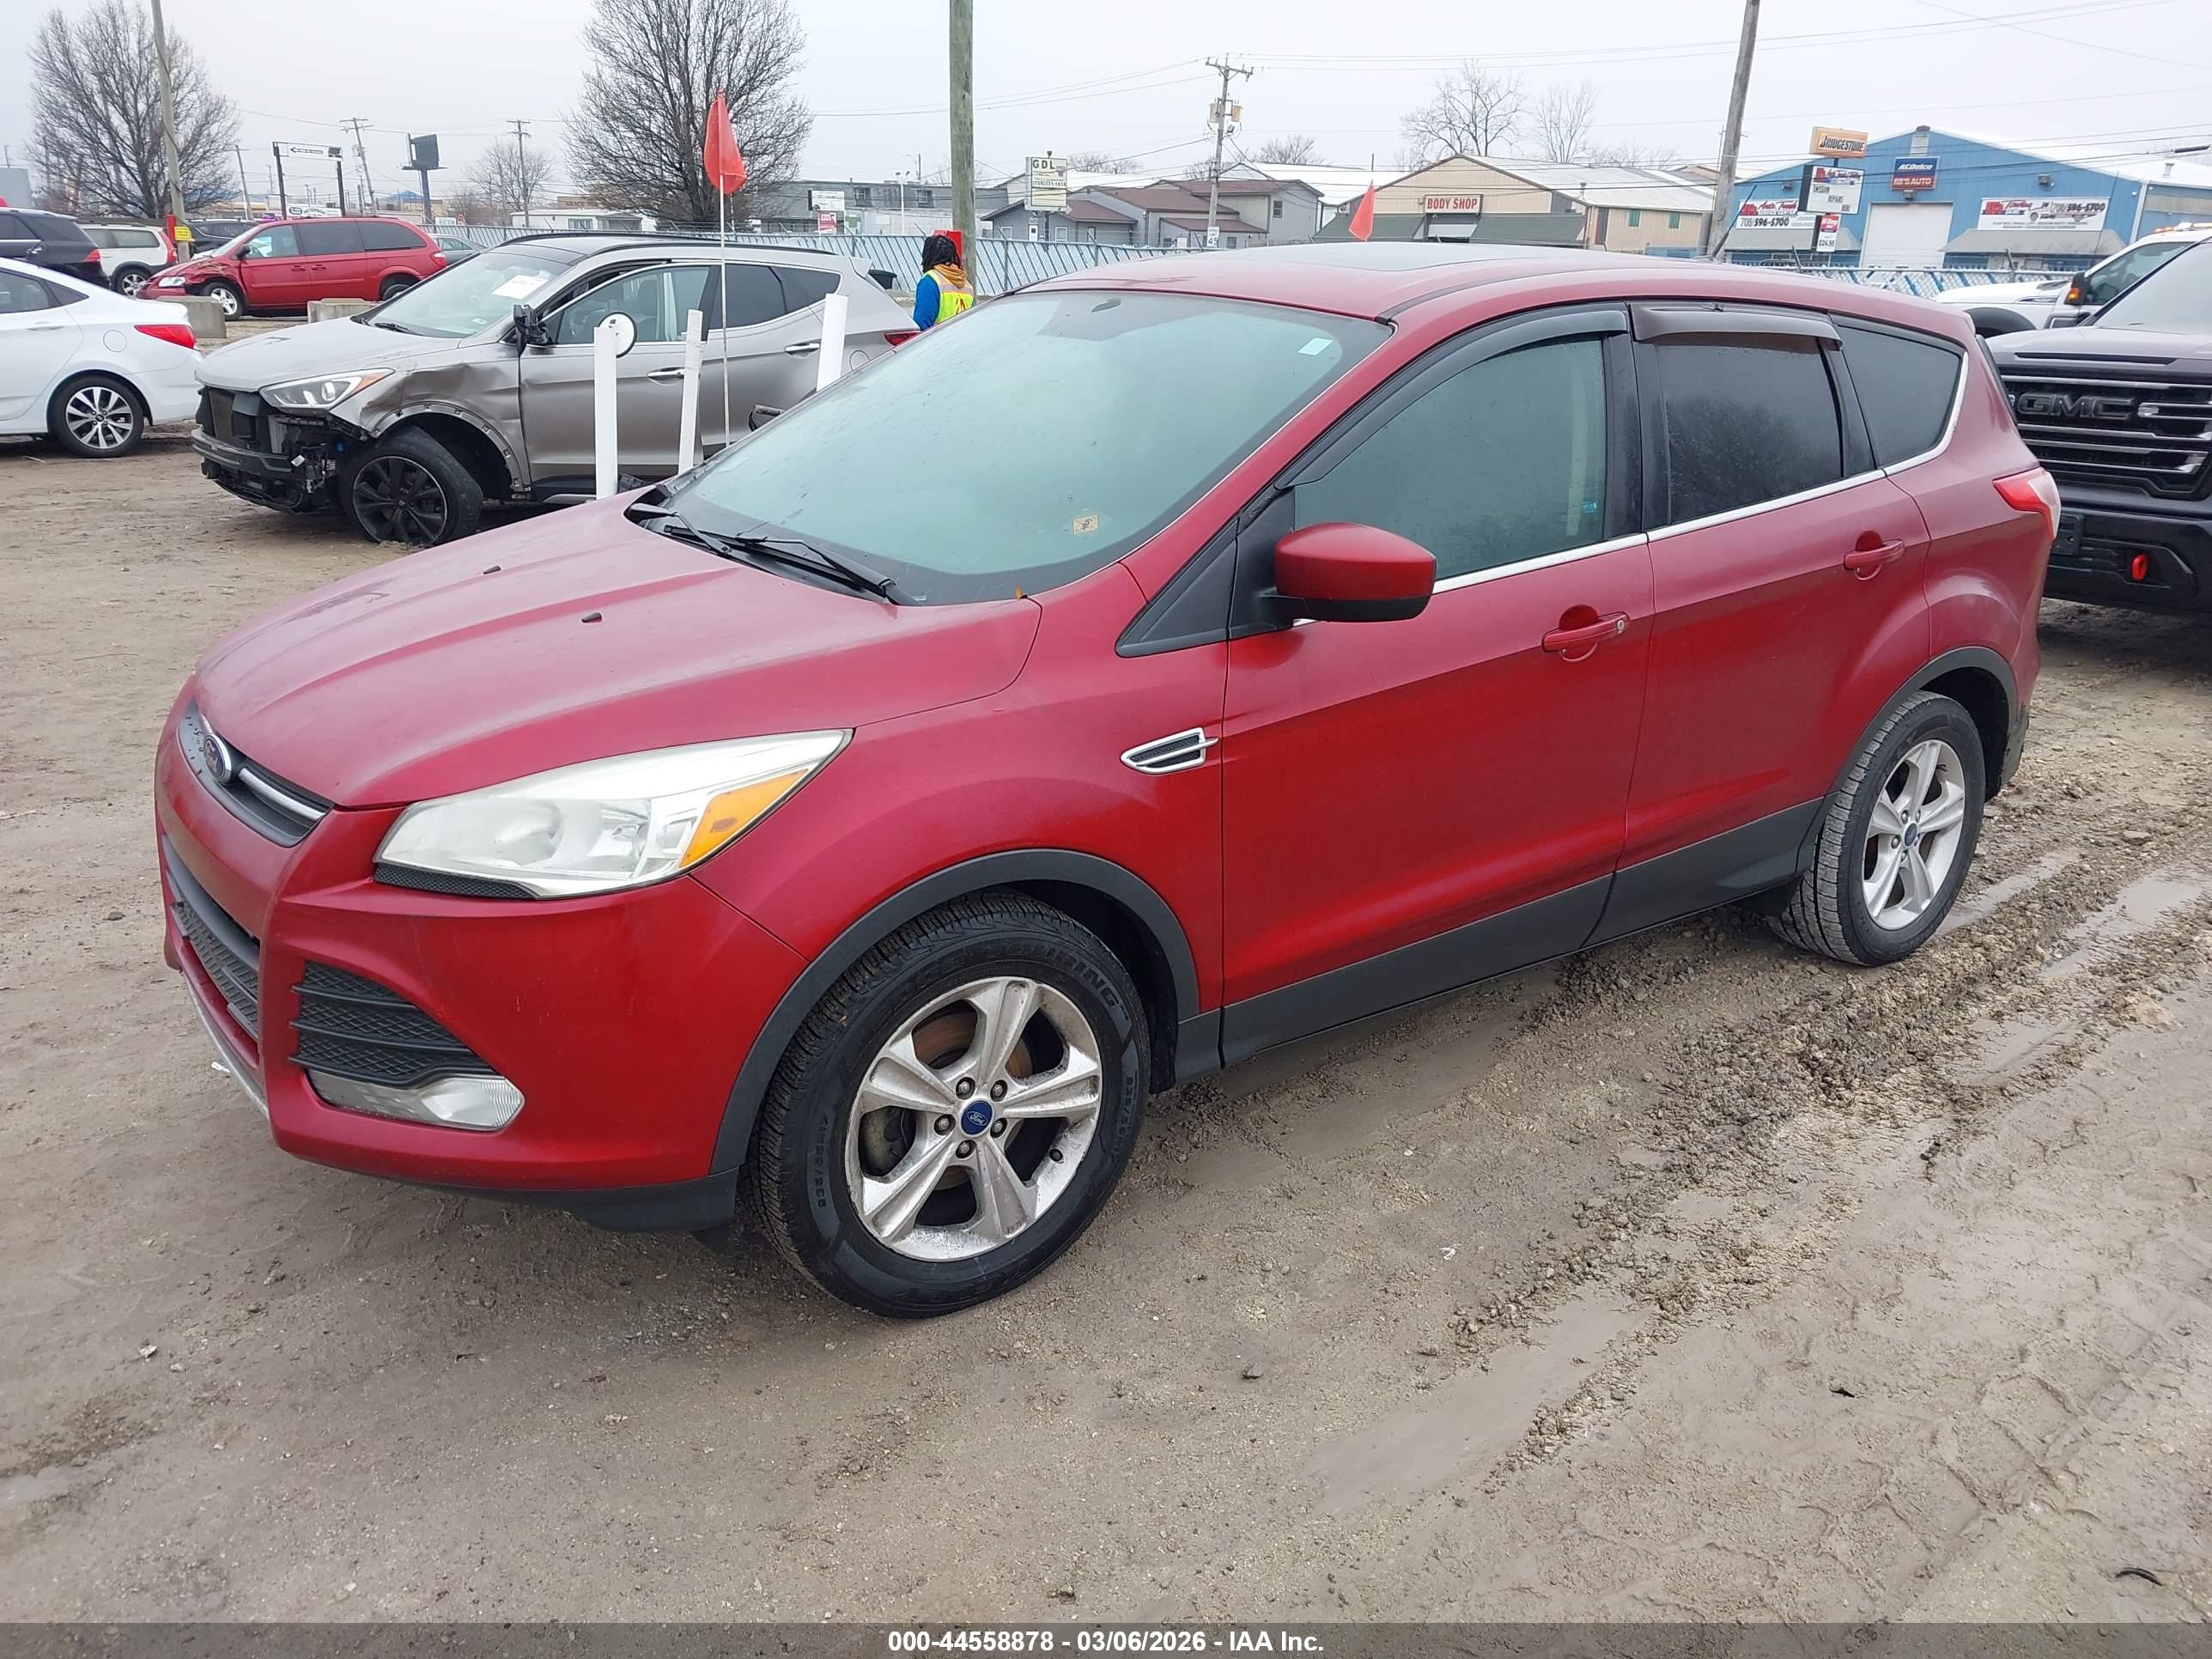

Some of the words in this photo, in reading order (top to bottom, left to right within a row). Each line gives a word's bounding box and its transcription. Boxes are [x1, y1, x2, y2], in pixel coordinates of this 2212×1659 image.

[1820, 135, 1866, 152] BRIDGESTONE
[1033, 160, 1055, 169] GDL
[1427, 198, 1451, 209] BODY
[1453, 198, 1478, 209] SHOP
[1208, 237, 1218, 246] 45
[2018, 393, 2135, 420] GMC
